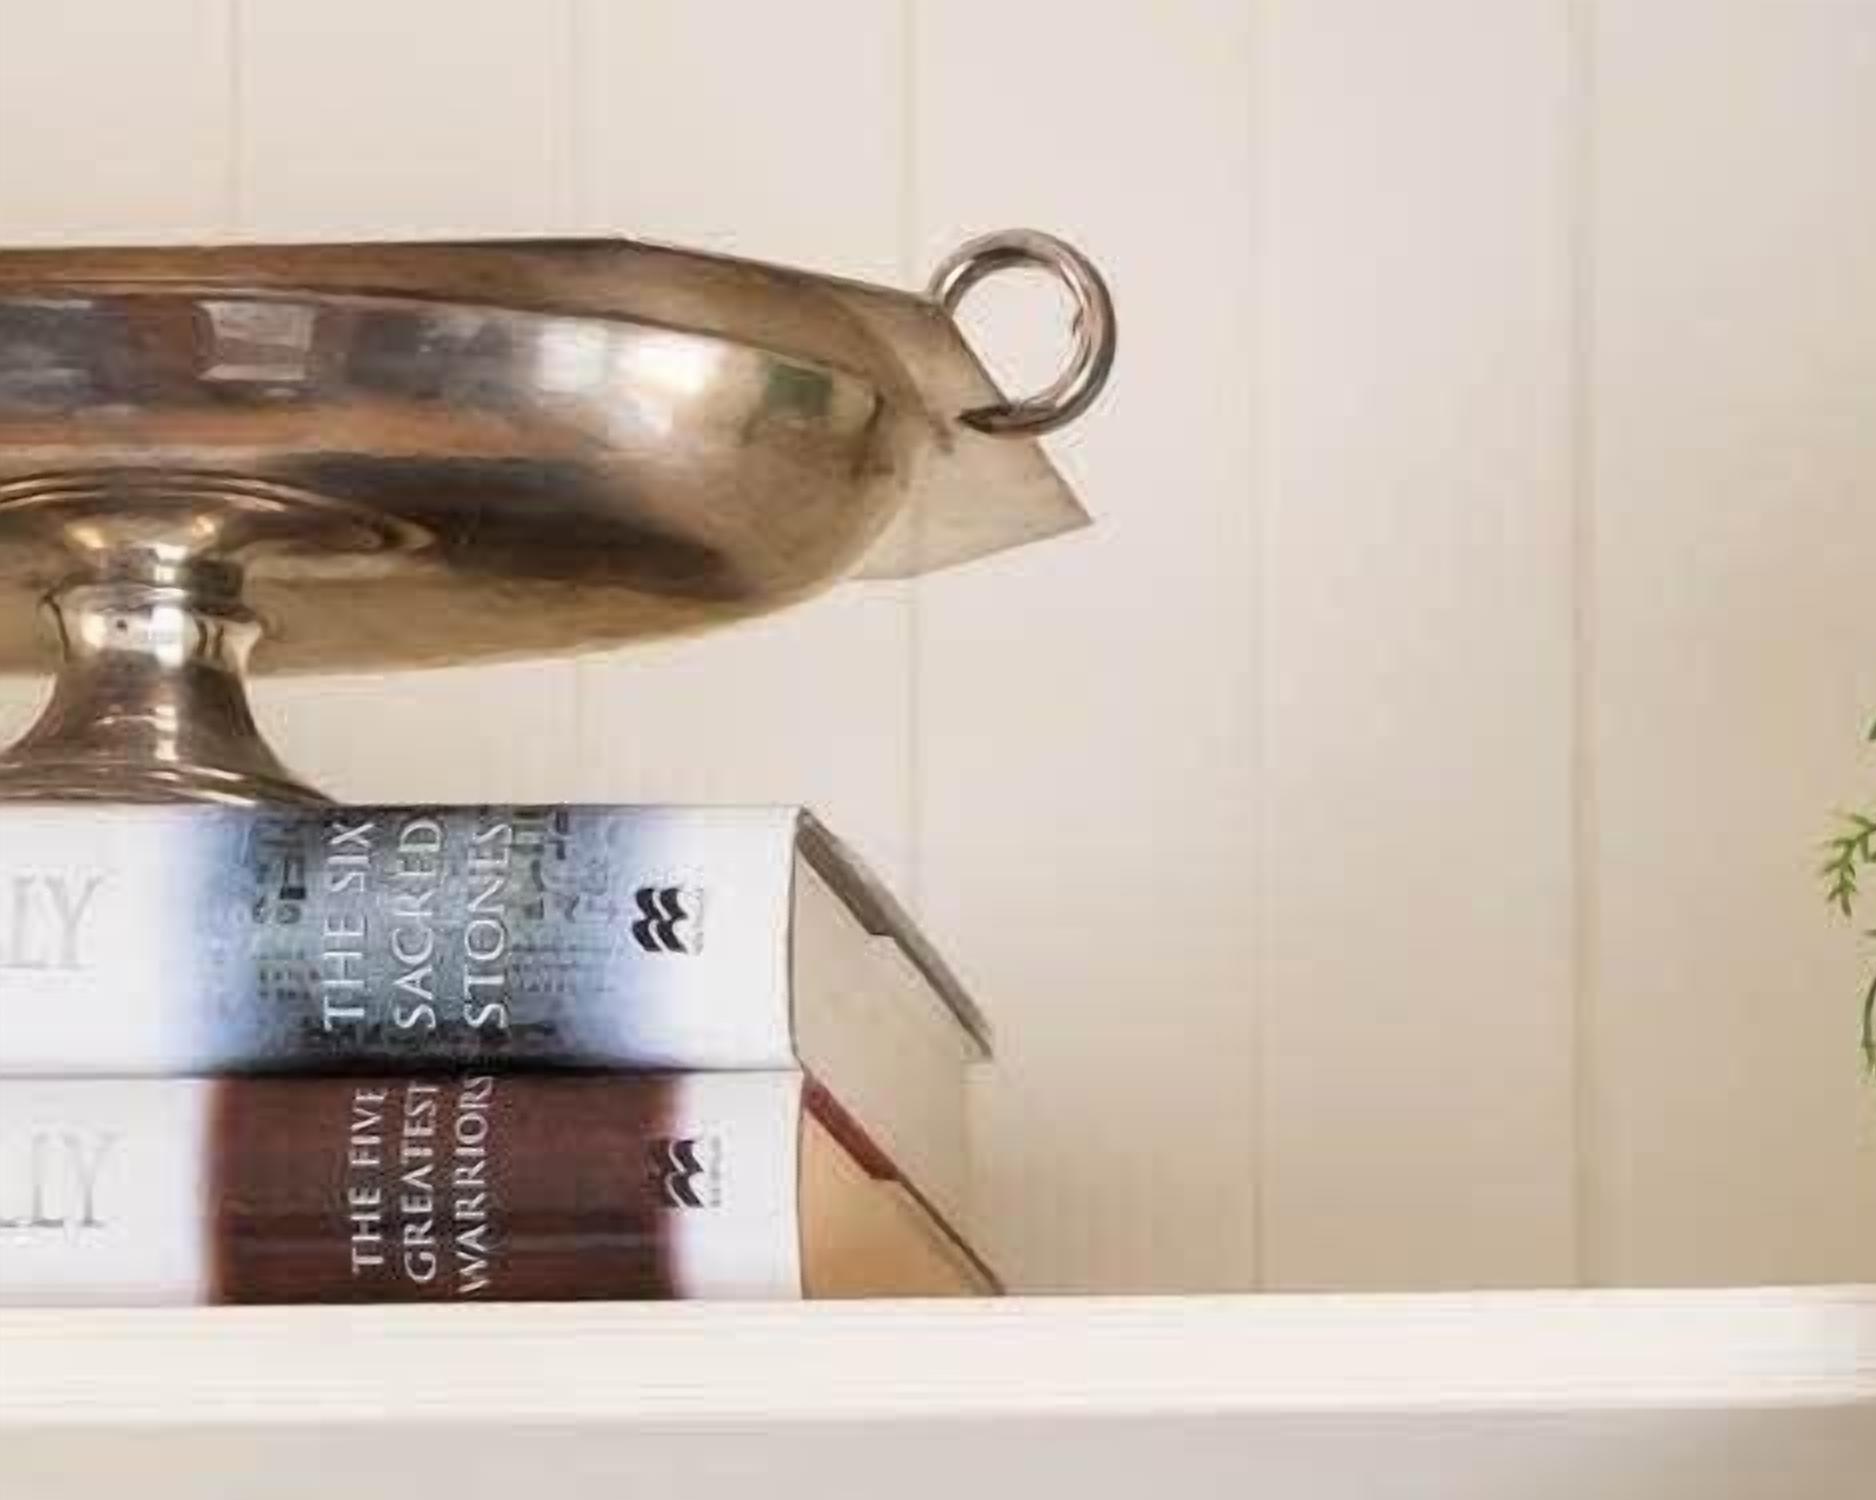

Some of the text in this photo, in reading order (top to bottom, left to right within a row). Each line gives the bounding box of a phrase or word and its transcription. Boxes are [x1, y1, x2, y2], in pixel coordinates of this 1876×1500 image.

[321, 820, 376, 1031] THE SIX
[391, 816, 444, 1032] SACRED
[462, 822, 513, 1031] STONES
[348, 1087, 389, 1275] THE FIVE
[400, 1081, 440, 1283] GREATEST
[453, 1075, 494, 1296] WARRIORS
